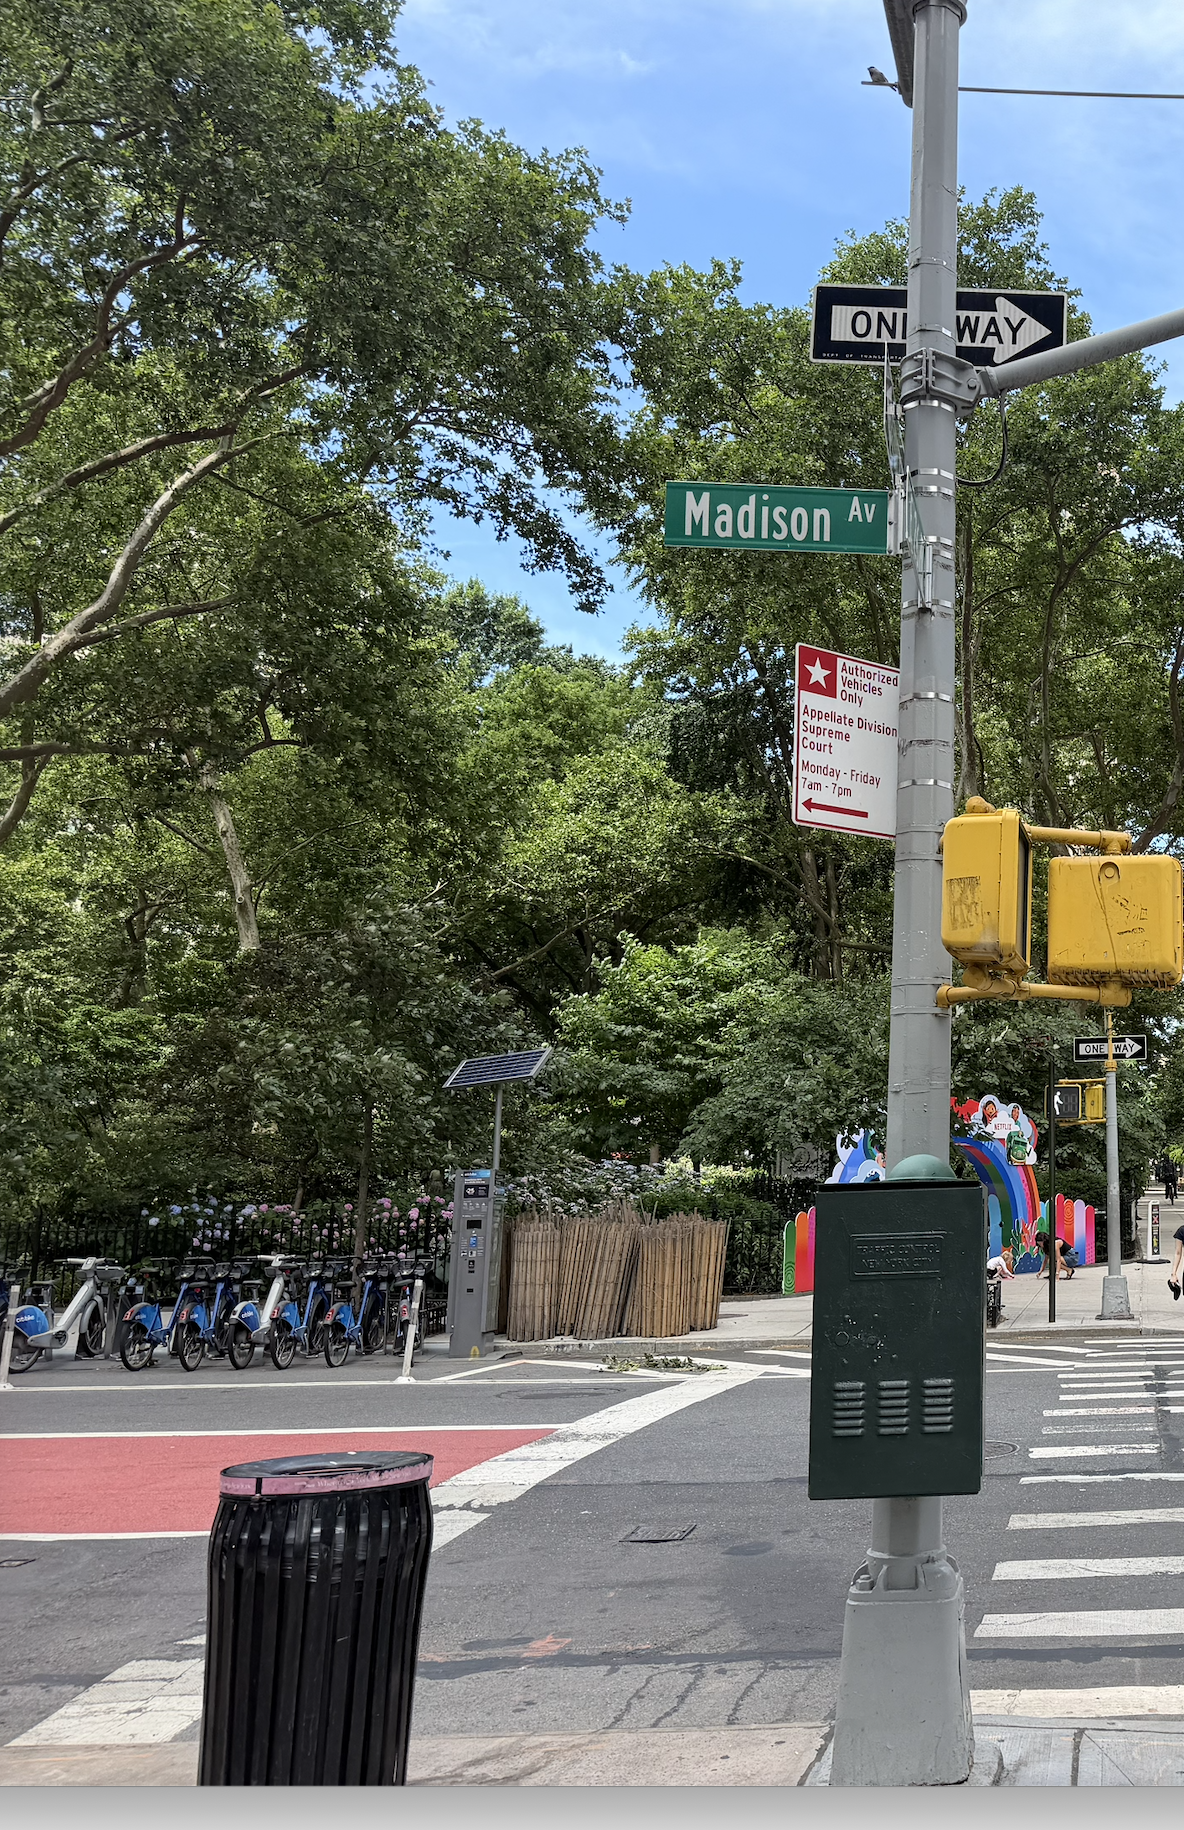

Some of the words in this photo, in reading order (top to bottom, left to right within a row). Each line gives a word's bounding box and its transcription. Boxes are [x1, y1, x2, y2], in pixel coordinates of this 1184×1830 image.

[956, 315, 1027, 345] WAY
[684, 490, 831, 542] Madison
[848, 496, 877, 523] Av
[841, 661, 899, 687] Authorized
[841, 675, 883, 697] Vehicles
[840, 689, 864, 708] Only
[802, 704, 854, 727] Appellate
[857, 717, 898, 737] Division
[802, 720, 851, 742] Supreme
[801, 736, 833, 755] Court
[801, 759, 841, 782] Monday
[850, 769, 881, 789] Friday
[801, 776, 822, 792] 7am
[831, 782, 852, 797] 7pm
[1084, 1044, 1105, 1054] ONE
[1113, 1043, 1135, 1053] WAY
[994, 1123, 1012, 1131] NETFLIX
[899, 1243, 940, 1254] CONTROL
